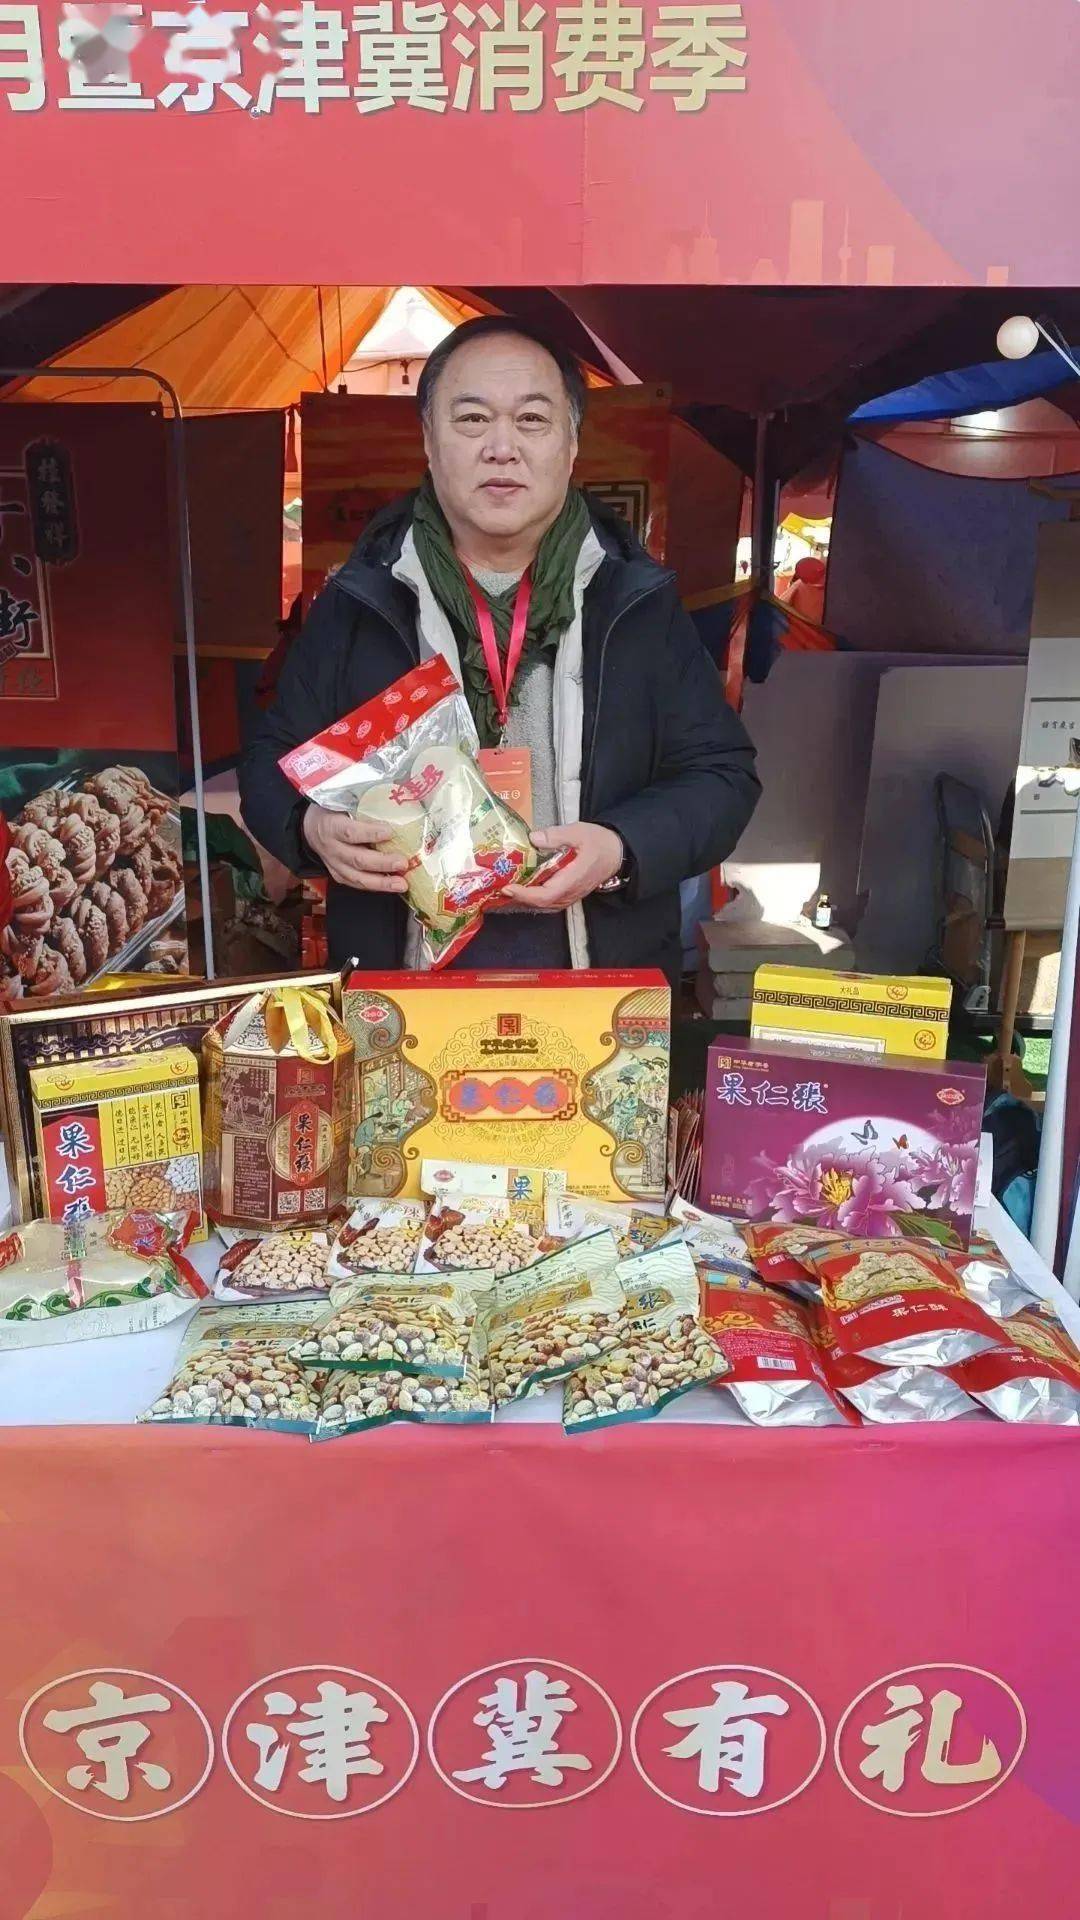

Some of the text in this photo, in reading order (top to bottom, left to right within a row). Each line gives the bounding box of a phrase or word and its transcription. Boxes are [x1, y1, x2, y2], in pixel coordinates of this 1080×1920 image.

[42, 1670, 1002, 1801] 京津冀有礼
